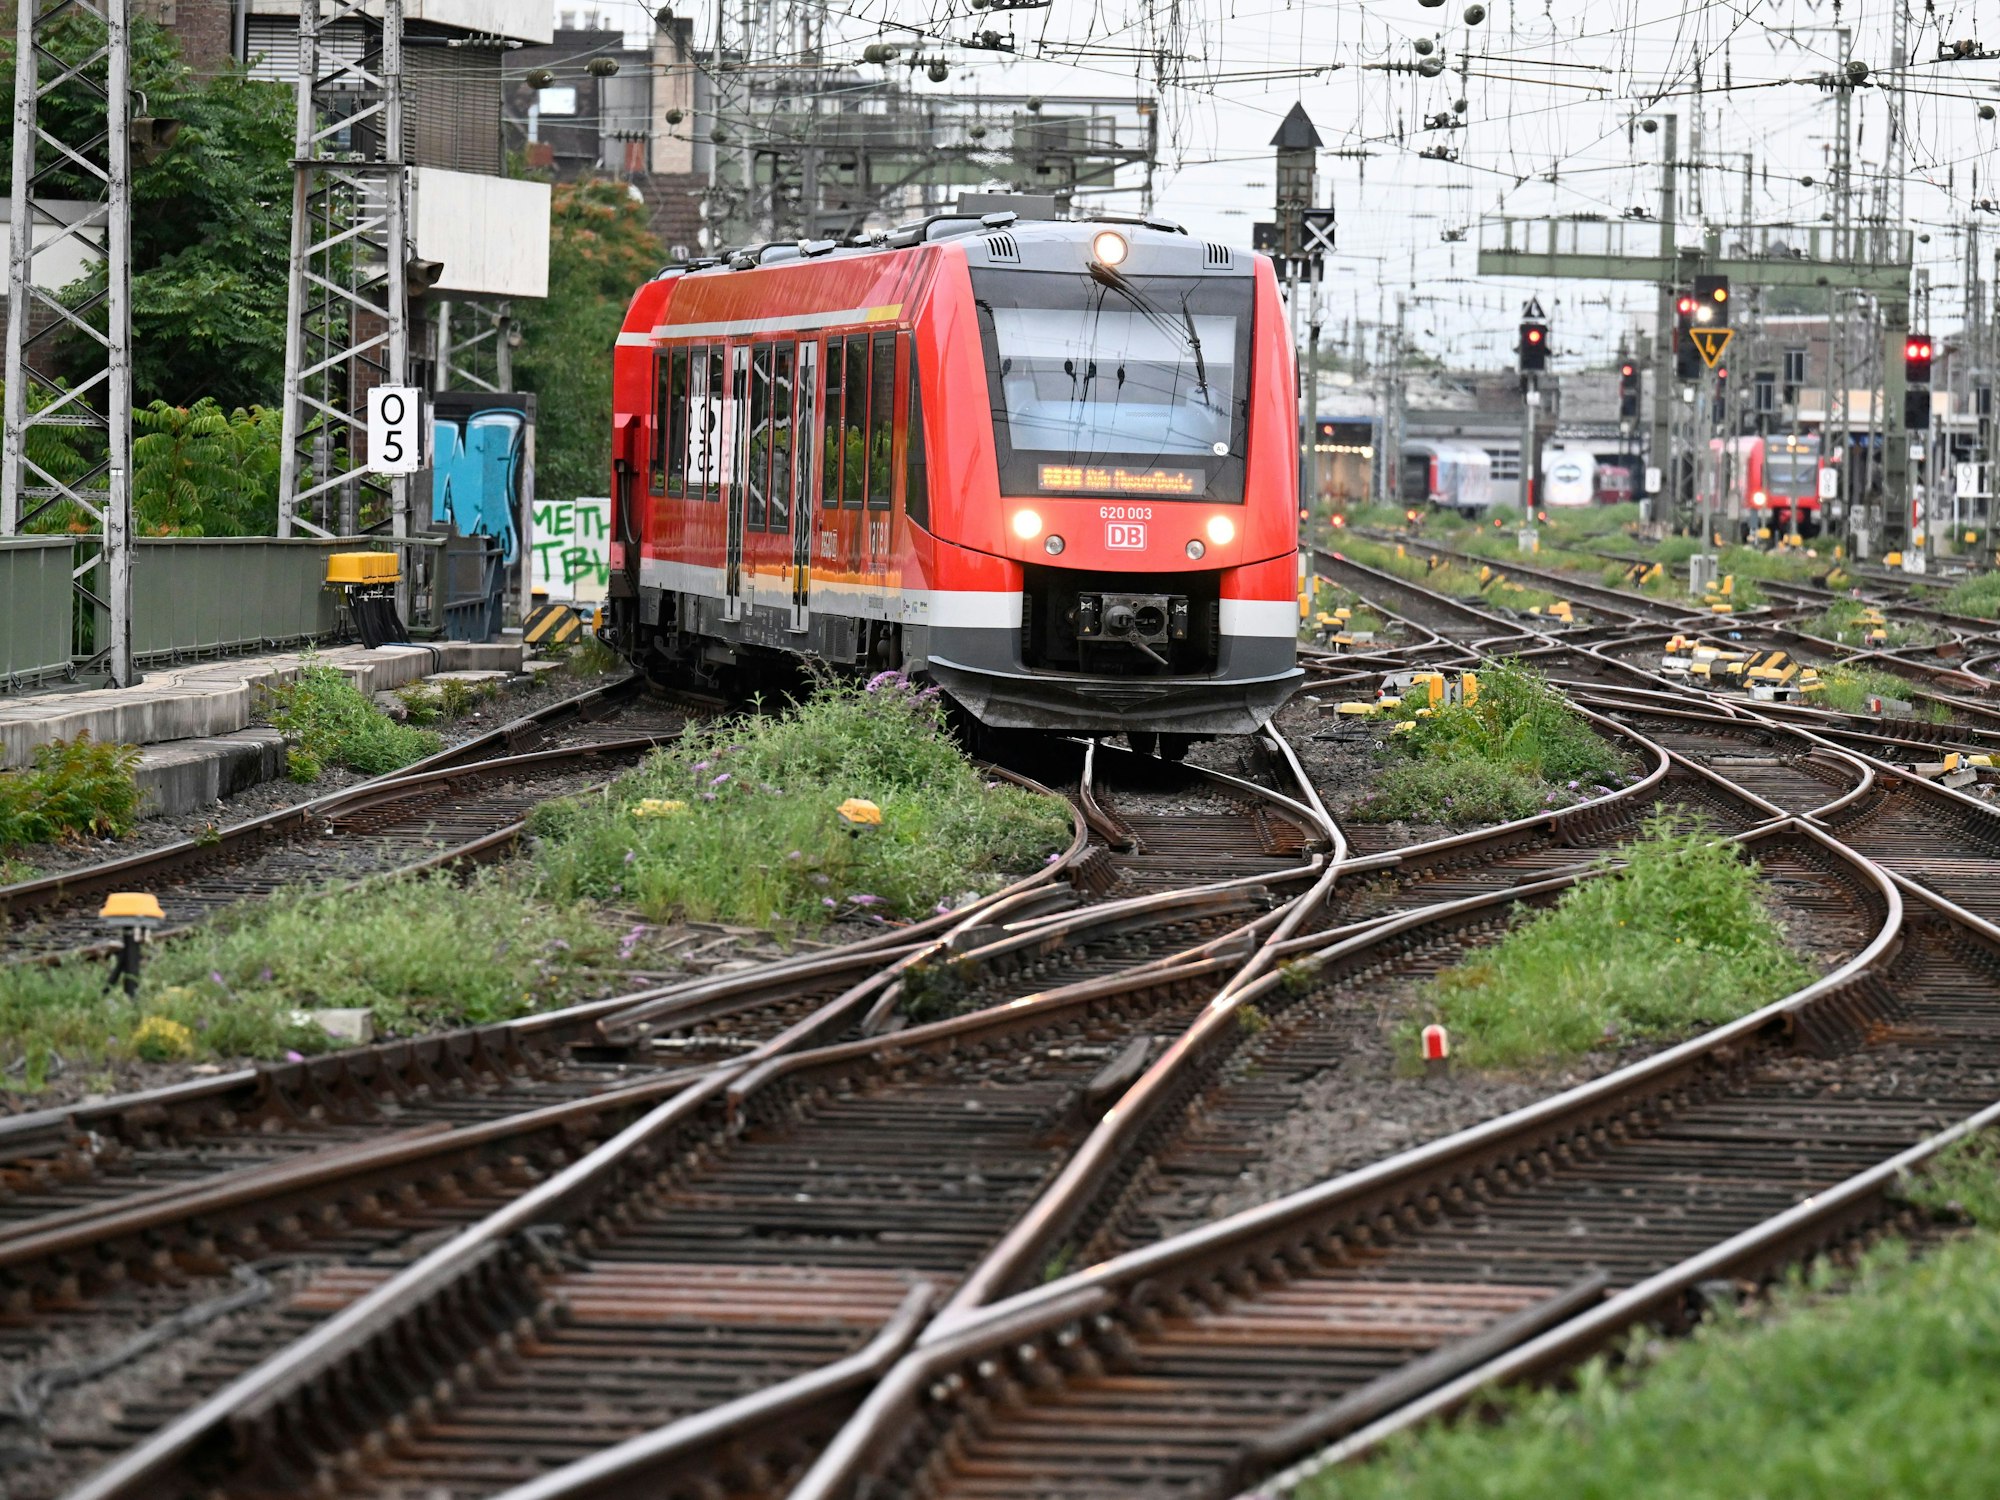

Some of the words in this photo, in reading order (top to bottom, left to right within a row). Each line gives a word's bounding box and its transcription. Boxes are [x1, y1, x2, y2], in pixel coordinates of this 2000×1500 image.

[1100, 506, 1125, 519] 620
[1127, 507, 1152, 520] 003
[1110, 526, 1142, 546] DB
